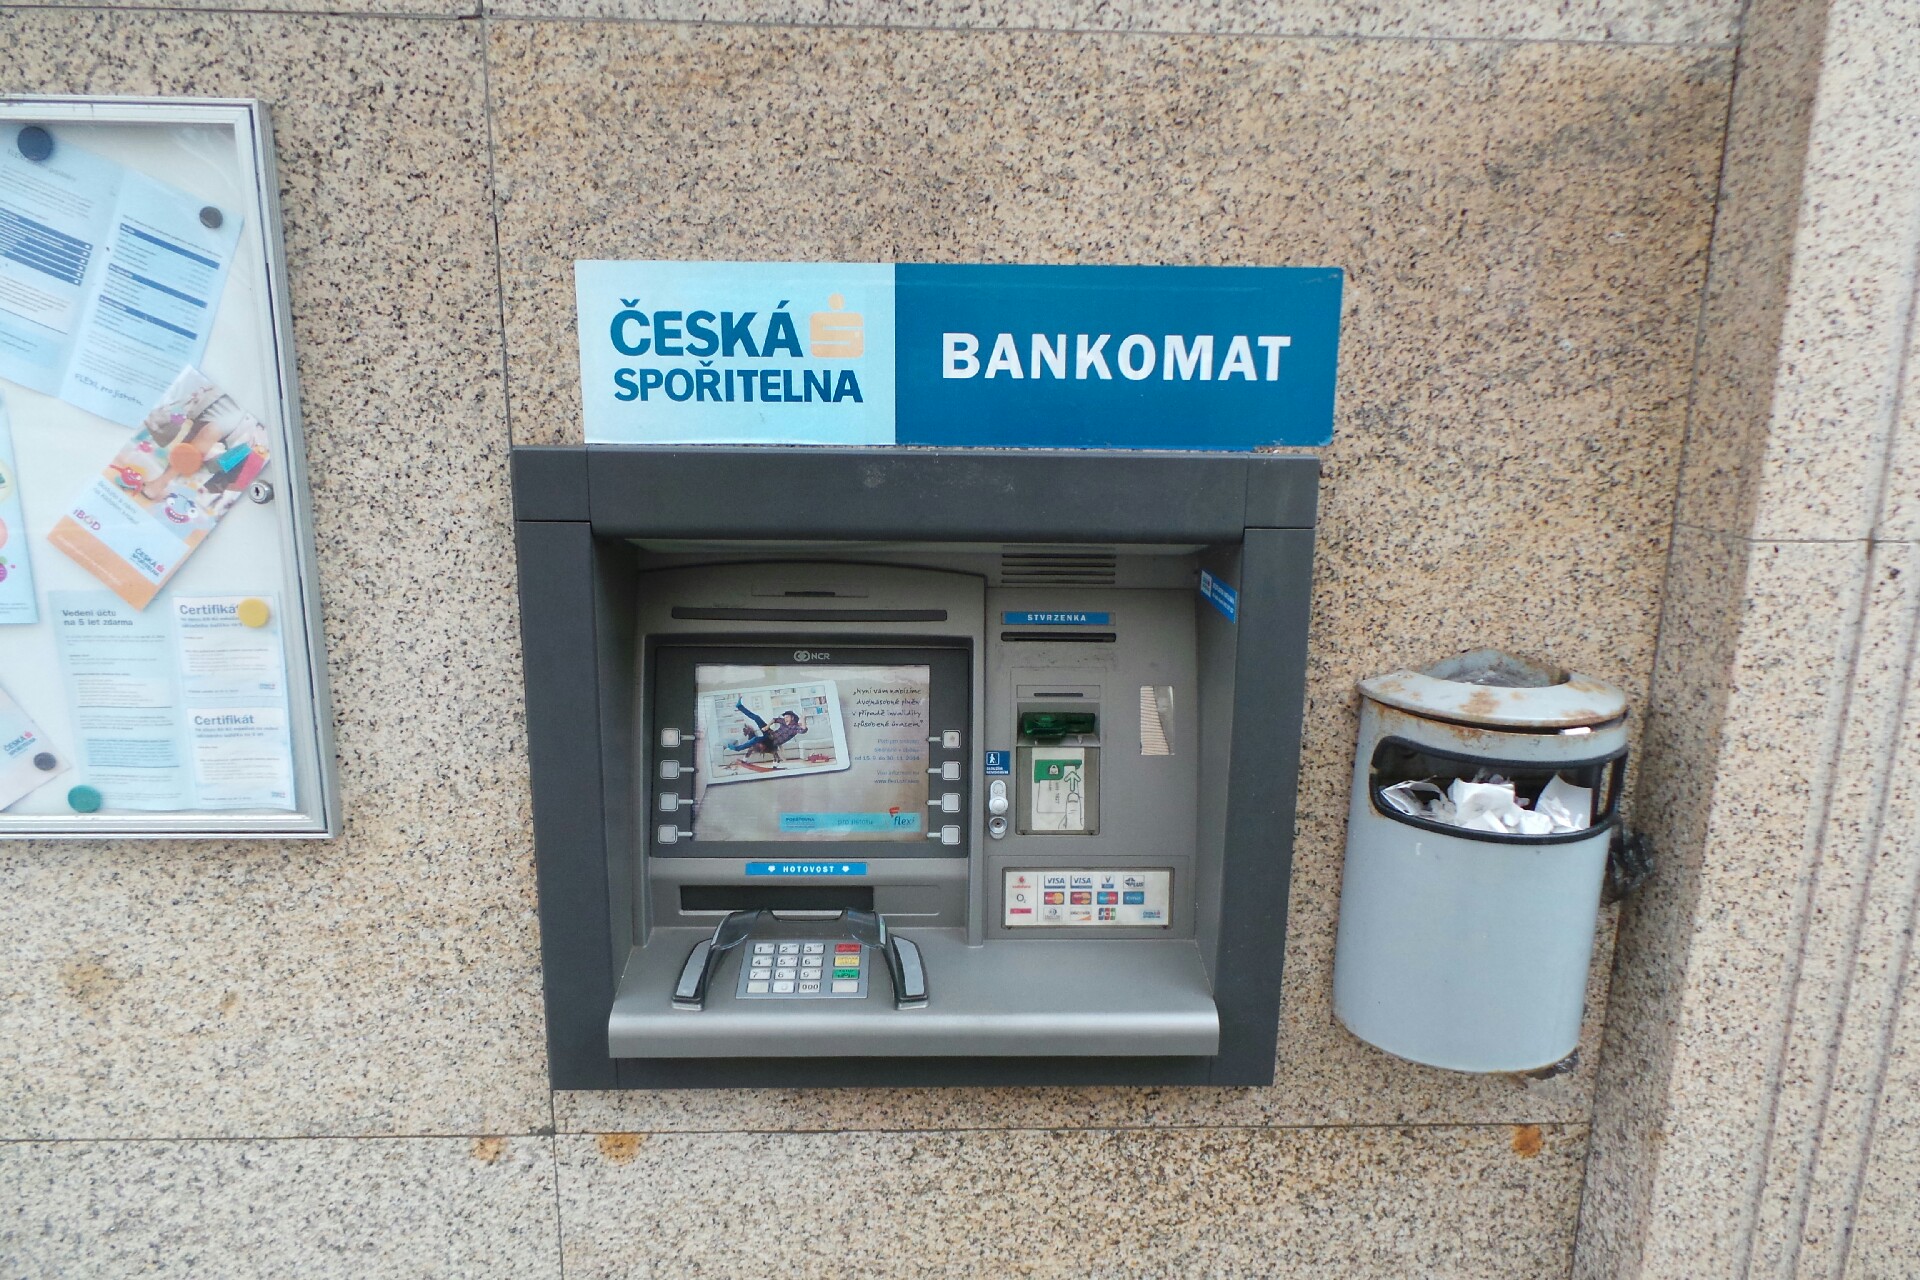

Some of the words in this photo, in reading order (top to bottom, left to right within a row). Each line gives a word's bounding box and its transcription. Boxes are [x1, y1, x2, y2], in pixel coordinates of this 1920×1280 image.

[610, 298, 804, 358] ČESKÁ
[942, 332, 1292, 382] BANKOMAT
[613, 360, 864, 403] SPOŘITELNA
[62, 608, 94, 618] Vedení
[180, 604, 240, 616] Certifiká
[88, 618, 100, 626] let
[103, 618, 134, 626] zdarma
[1027, 614, 1087, 622] STVRZENKA
[810, 652, 830, 660] NCR
[194, 714, 254, 726] Certifikát
[894, 815, 915, 827] flexi
[1130, 880, 1144, 888] PLUS
